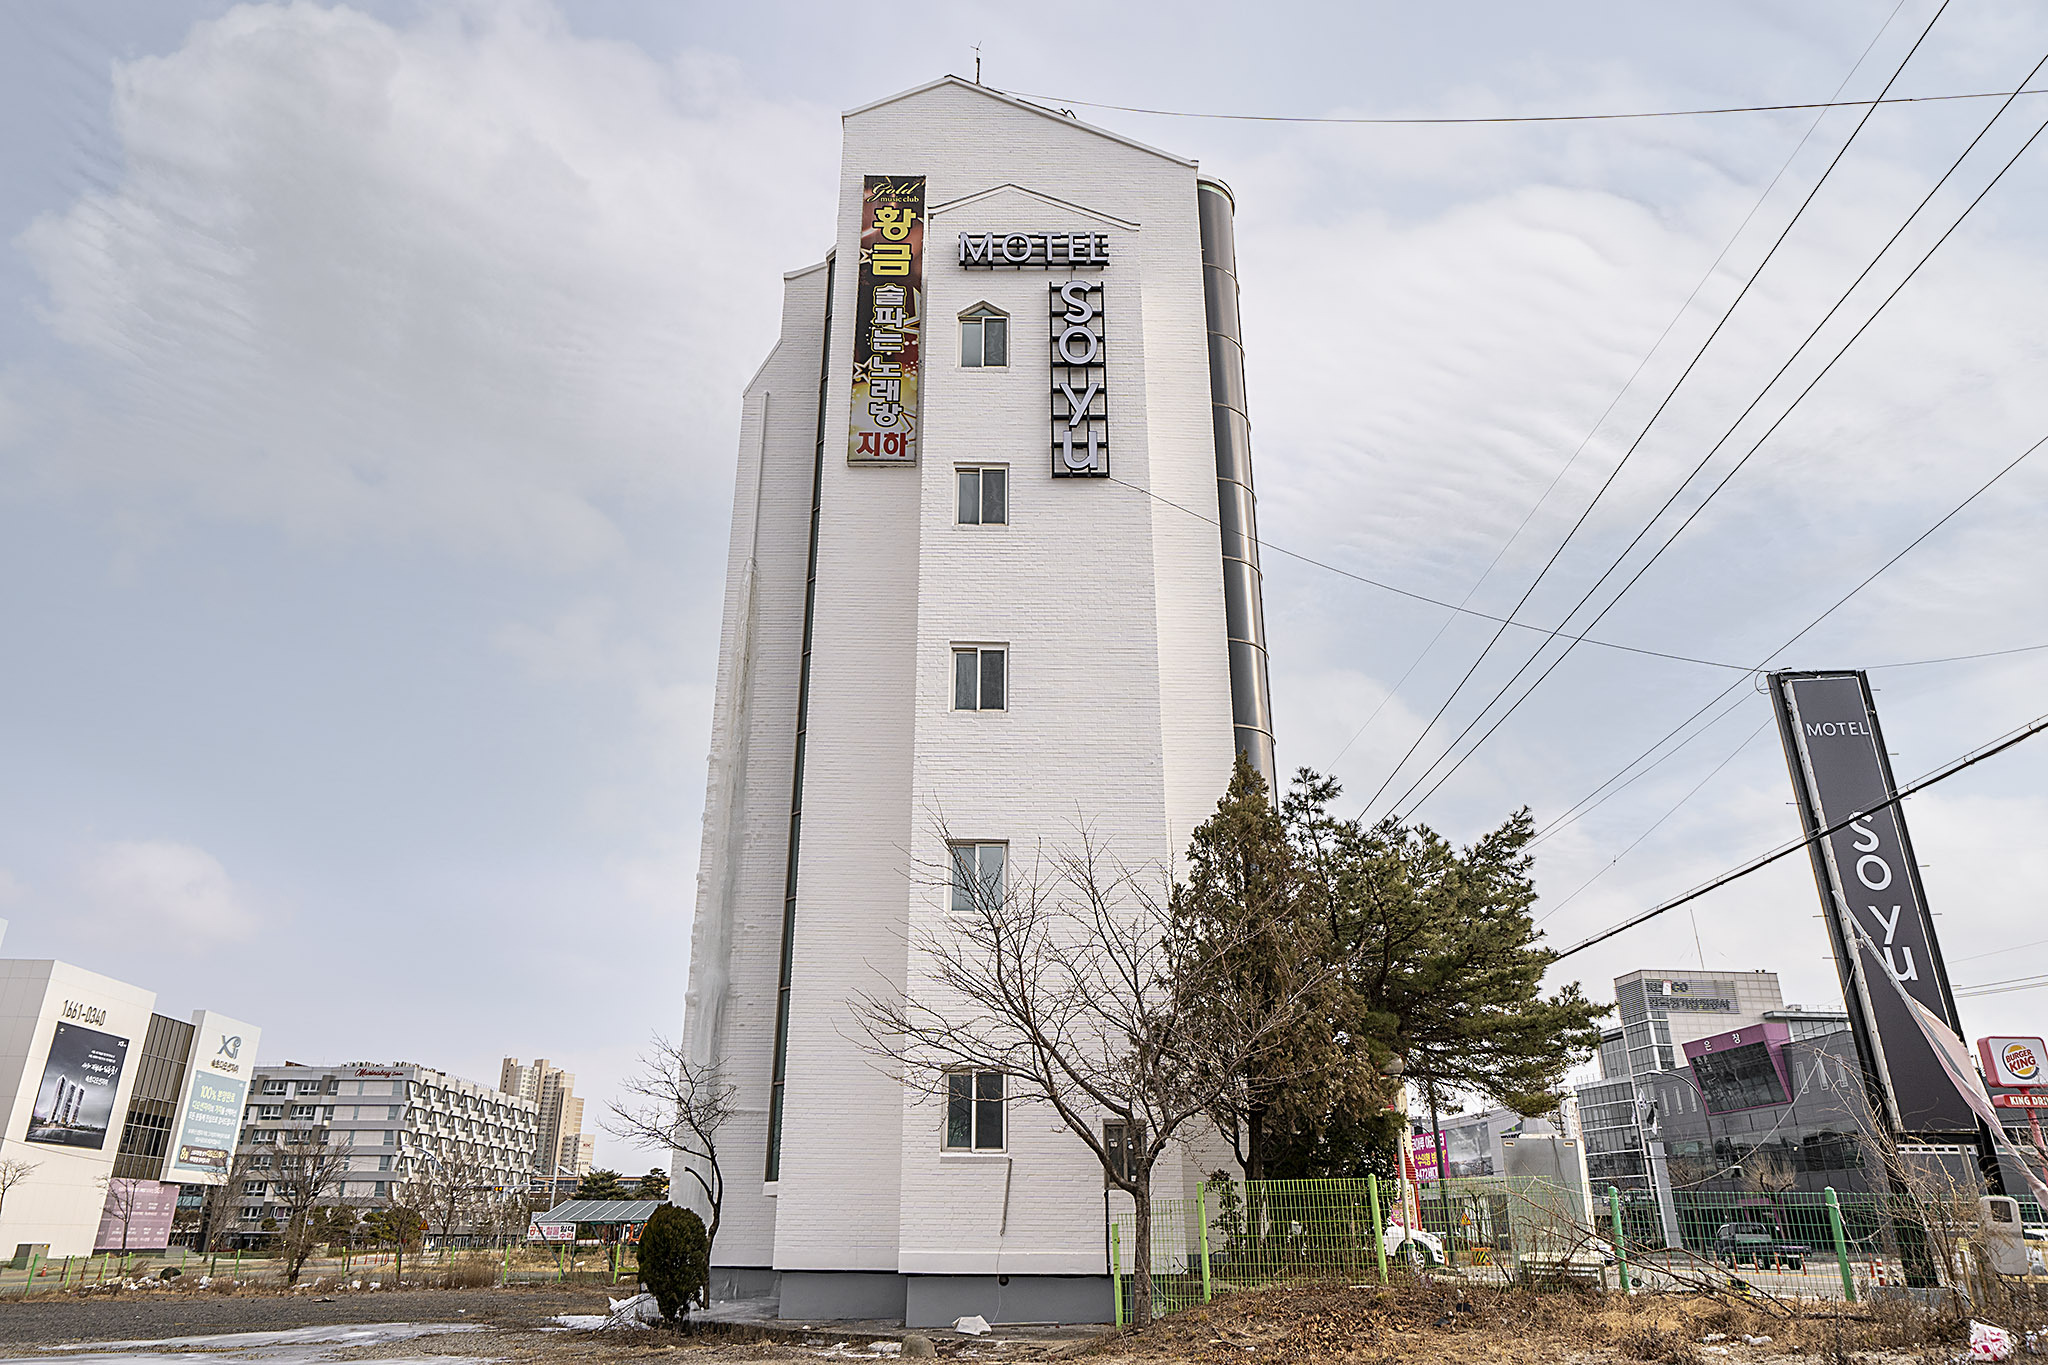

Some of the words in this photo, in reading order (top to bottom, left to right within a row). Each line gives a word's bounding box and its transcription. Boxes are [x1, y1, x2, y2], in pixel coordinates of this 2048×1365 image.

[866, 182, 920, 202] Gold
[902, 195, 920, 203] club
[873, 206, 917, 276] 황금
[959, 231, 1109, 263] MOTEL
[872, 284, 908, 352] 술파는
[869, 355, 903, 427] 노래방
[856, 432, 908, 457] 지하
[1805, 722, 1870, 737] MOTEL
[62, 1000, 106, 1026] 1661-0340
[2006, 1049, 2032, 1063] BURGER
[2009, 1055, 2036, 1073] KING
[200, 1085, 217, 1101] 100%
[2009, 1096, 2031, 1105] KING
